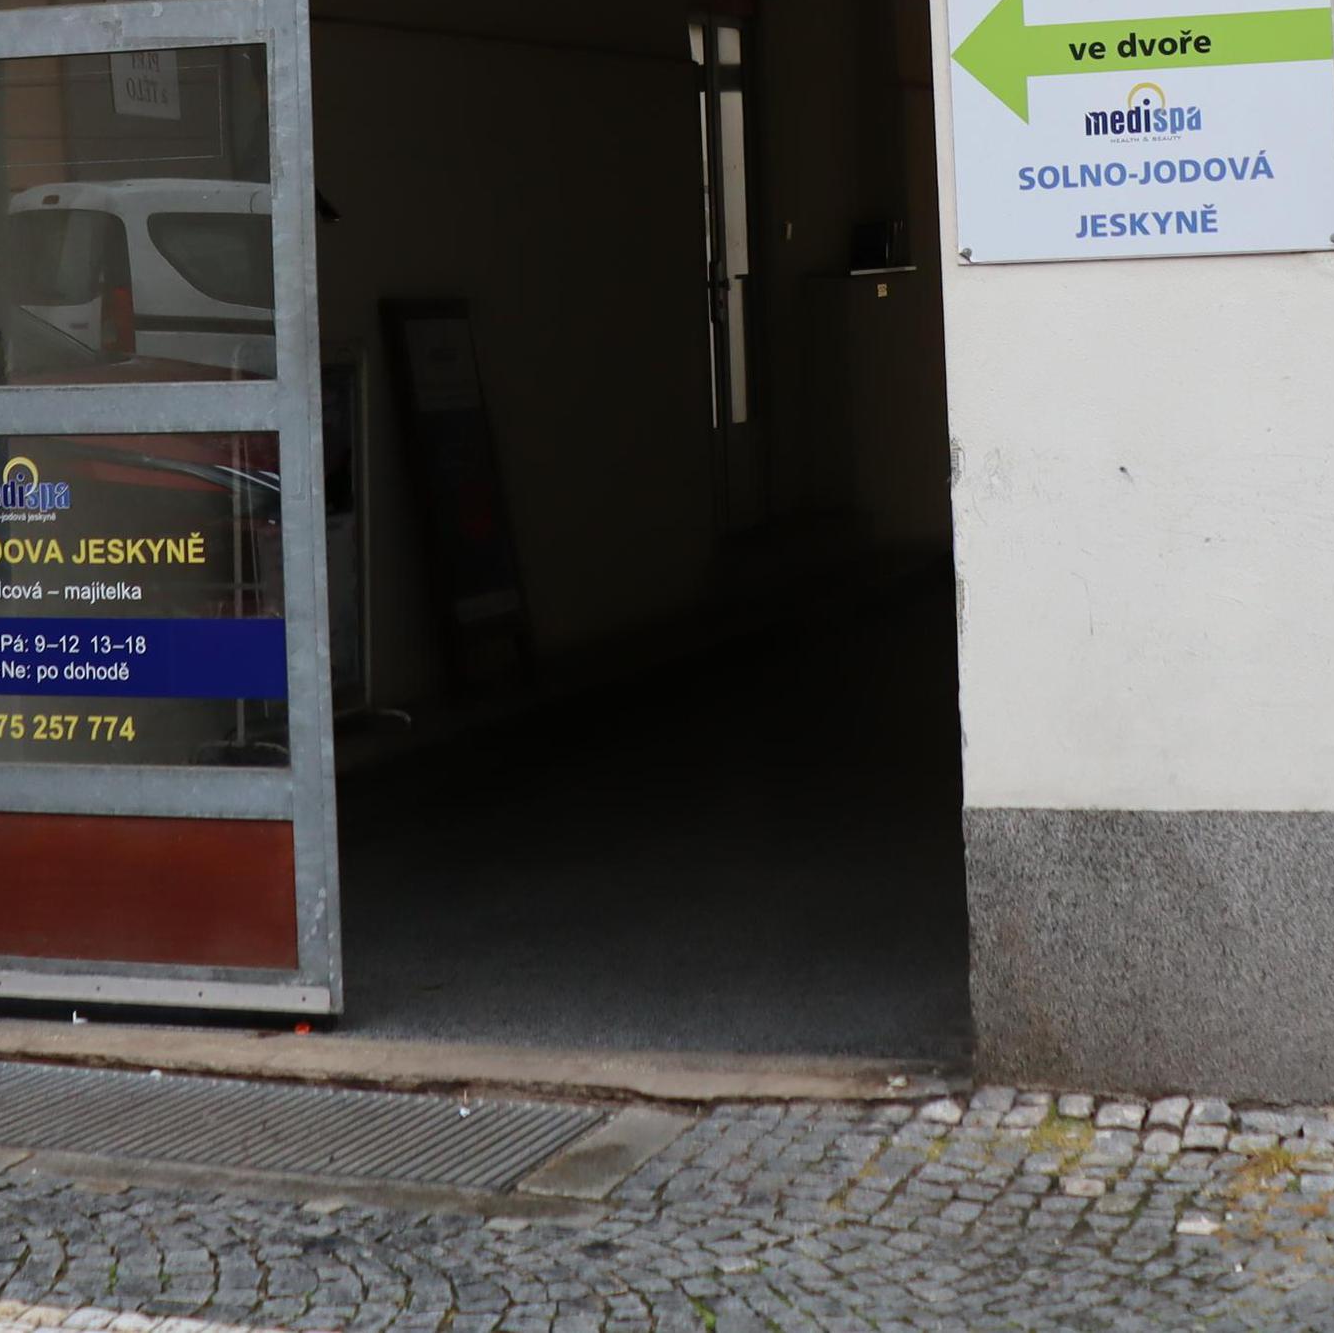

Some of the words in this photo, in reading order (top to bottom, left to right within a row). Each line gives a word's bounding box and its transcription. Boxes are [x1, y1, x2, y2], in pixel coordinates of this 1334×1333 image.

[1069, 38, 1106, 61] ve
[1117, 29, 1212, 58] dvoře
[1085, 98, 1202, 135] medispa
[1018, 149, 1274, 191] SOLNO-JODOVÁ
[1075, 203, 1218, 239] JESKYNĚ
[72, 531, 206, 564] JESKYNĚ
[64, 580, 142, 603] majitelka
[37, 665, 58, 683] po
[63, 660, 130, 681] dohodě
[32, 714, 78, 741] 257
[87, 715, 136, 742] 774
